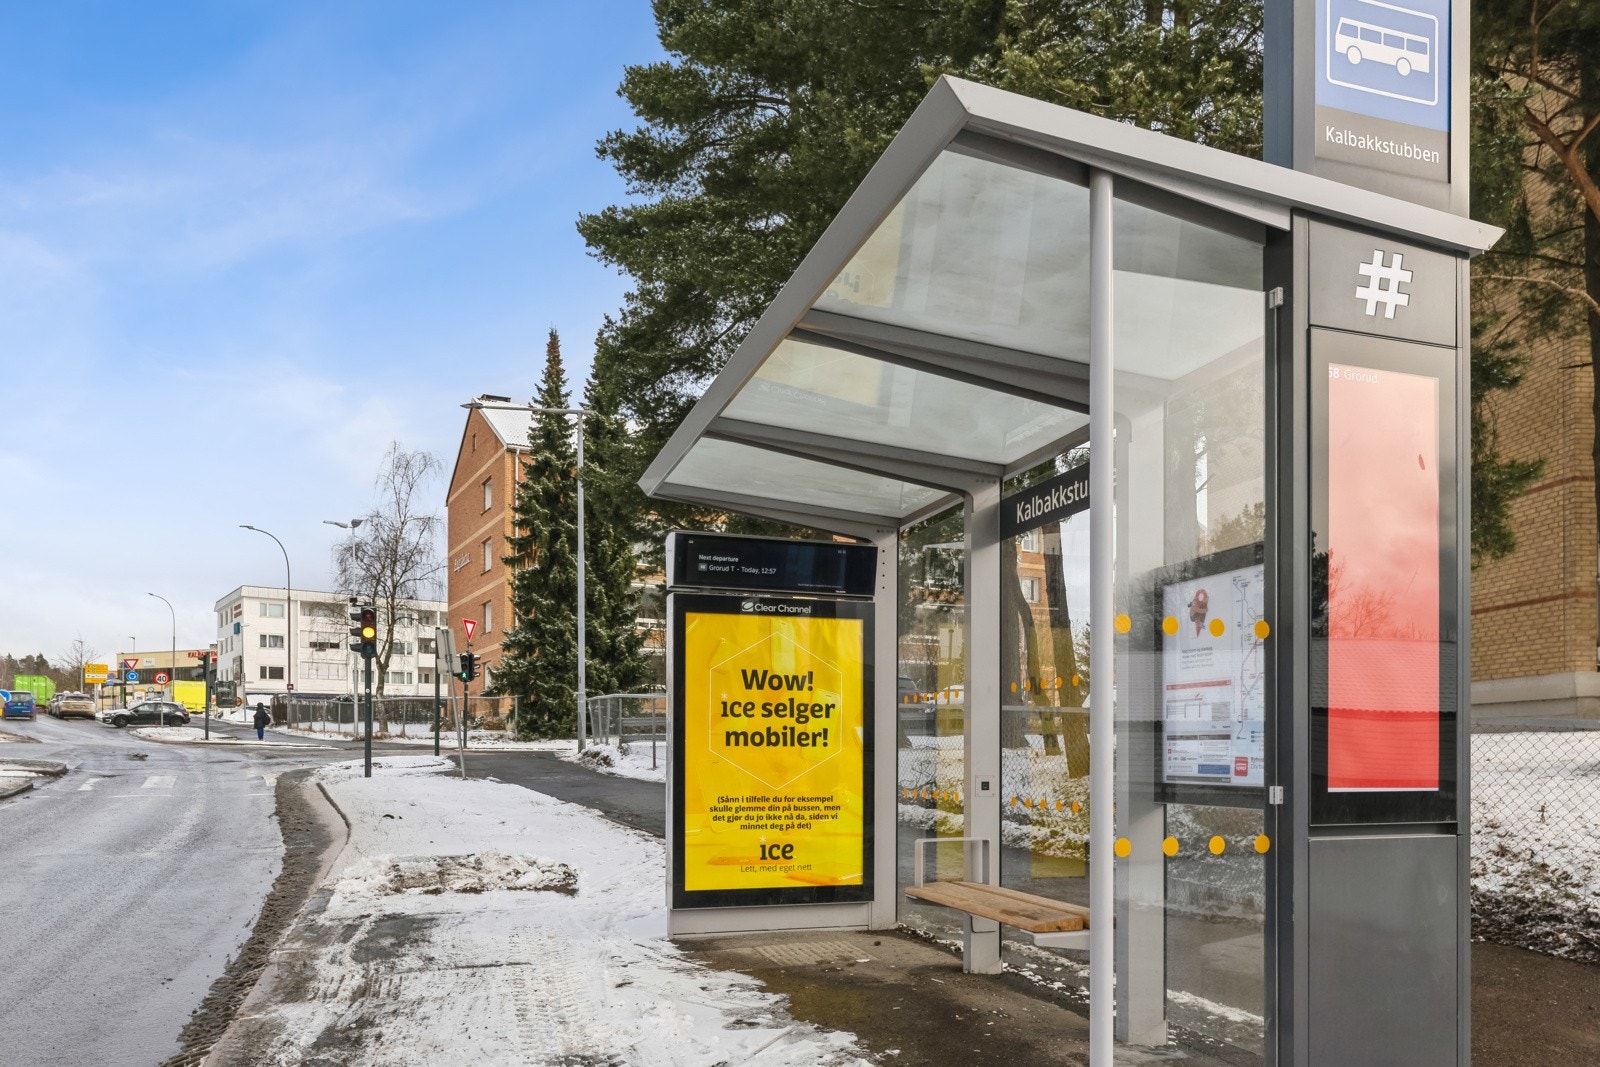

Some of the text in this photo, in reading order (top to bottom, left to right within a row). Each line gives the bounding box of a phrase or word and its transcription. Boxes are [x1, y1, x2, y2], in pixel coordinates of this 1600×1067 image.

[1326, 126, 1439, 163] Kalbakkstubben
[1344, 369, 1378, 384] Grorud
[1016, 479, 1088, 523] Kalbakkstu
[712, 555, 739, 563] departure
[708, 564, 730, 572] Grorud
[741, 566, 760, 575] Today,
[761, 567, 777, 575] 12:57
[754, 603, 812, 614] Clear Channel
[741, 669, 814, 691] Wow!
[721, 695, 836, 724] ice selger
[725, 725, 829, 748] mobiler!
[717, 795, 740, 804] (Sånn
[746, 795, 771, 803] tilfelle
[784, 795, 796, 803] for
[797, 795, 834, 805] eksempel
[709, 805, 733, 813] skulle
[734, 805, 766, 815] glemme
[782, 804, 792, 814] på
[793, 804, 823, 813] bussen,
[712, 814, 725, 822] det
[726, 814, 743, 824] gjør
[755, 814, 764, 824] jo
[765, 813, 782, 821] ikke
[795, 813, 808, 821] da,
[809, 812, 830, 820] siden
[830, 812, 838, 820] vi
[740, 822, 812, 832] minnet deg på det)
[759, 838, 794, 861] ice
[740, 863, 812, 873] Lett, med eget nett
